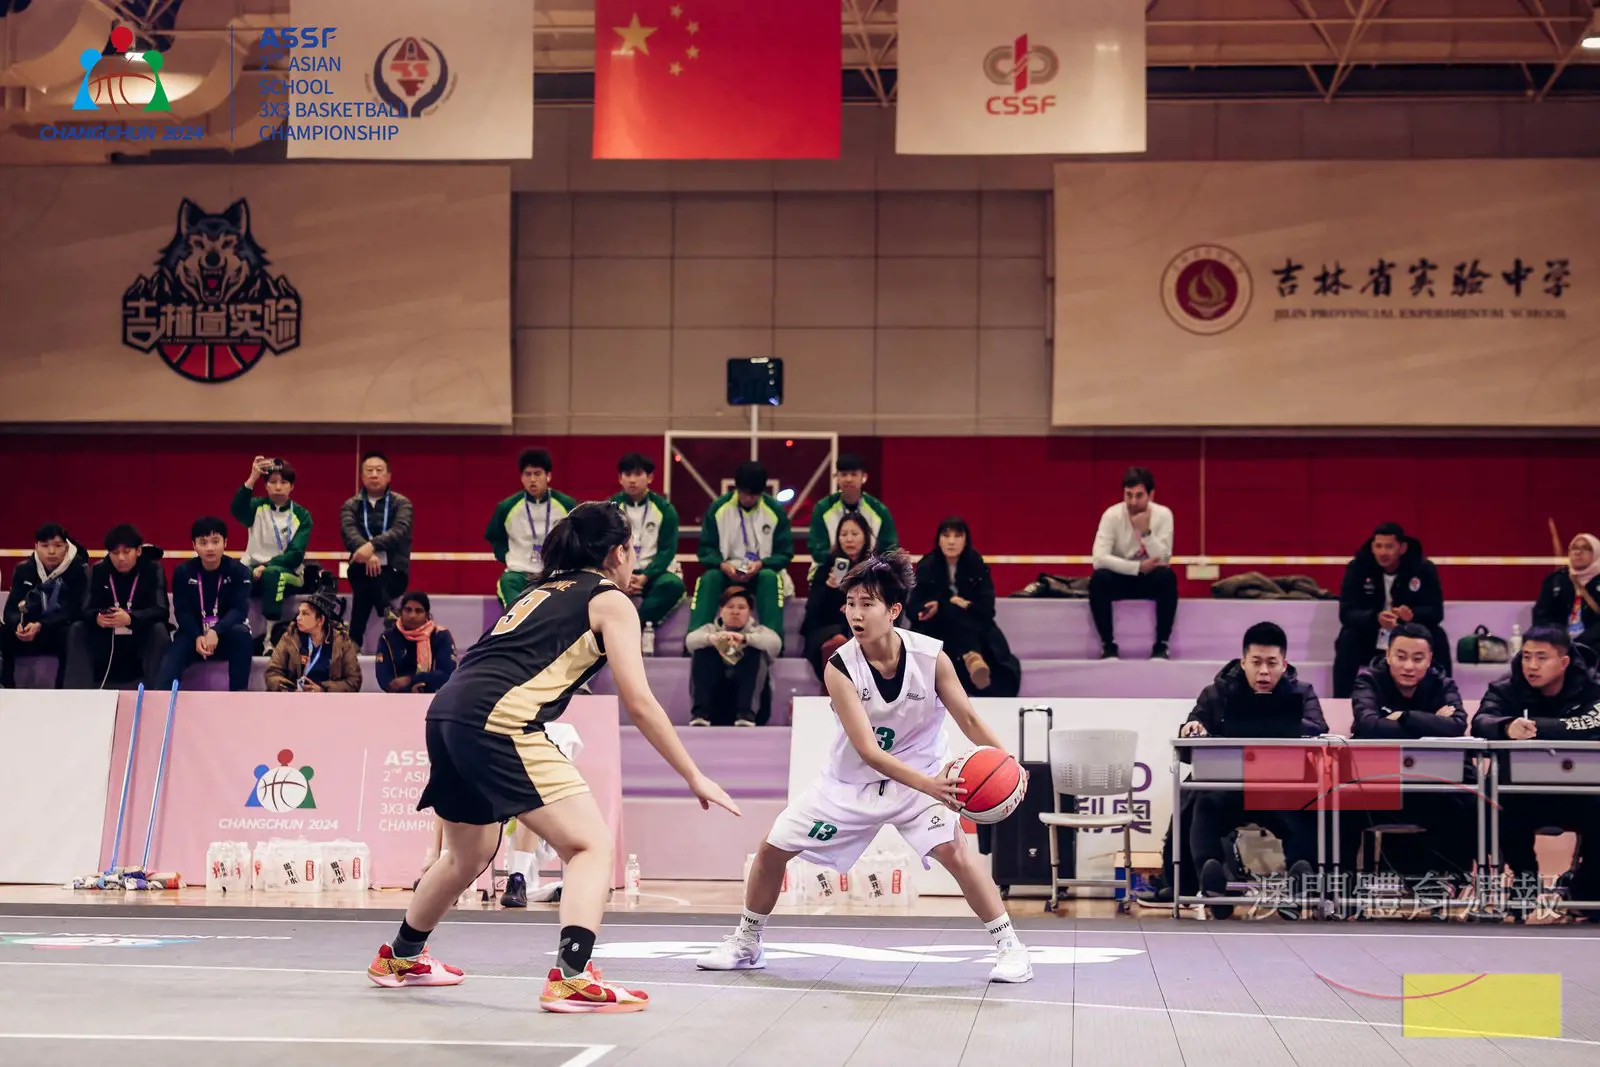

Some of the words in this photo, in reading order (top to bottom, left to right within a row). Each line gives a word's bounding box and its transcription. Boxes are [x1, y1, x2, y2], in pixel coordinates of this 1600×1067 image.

[986, 95, 1056, 115] CSSF
[1272, 257, 1571, 298] 吉林省实验中学
[490, 589, 551, 636] 9
[872, 726, 896, 751] 3
[405, 771, 430, 782] ASI
[380, 802, 404, 815] 3X3
[218, 818, 303, 830] CHANGCHUN
[308, 819, 338, 830] 2024
[807, 820, 838, 841] 13
